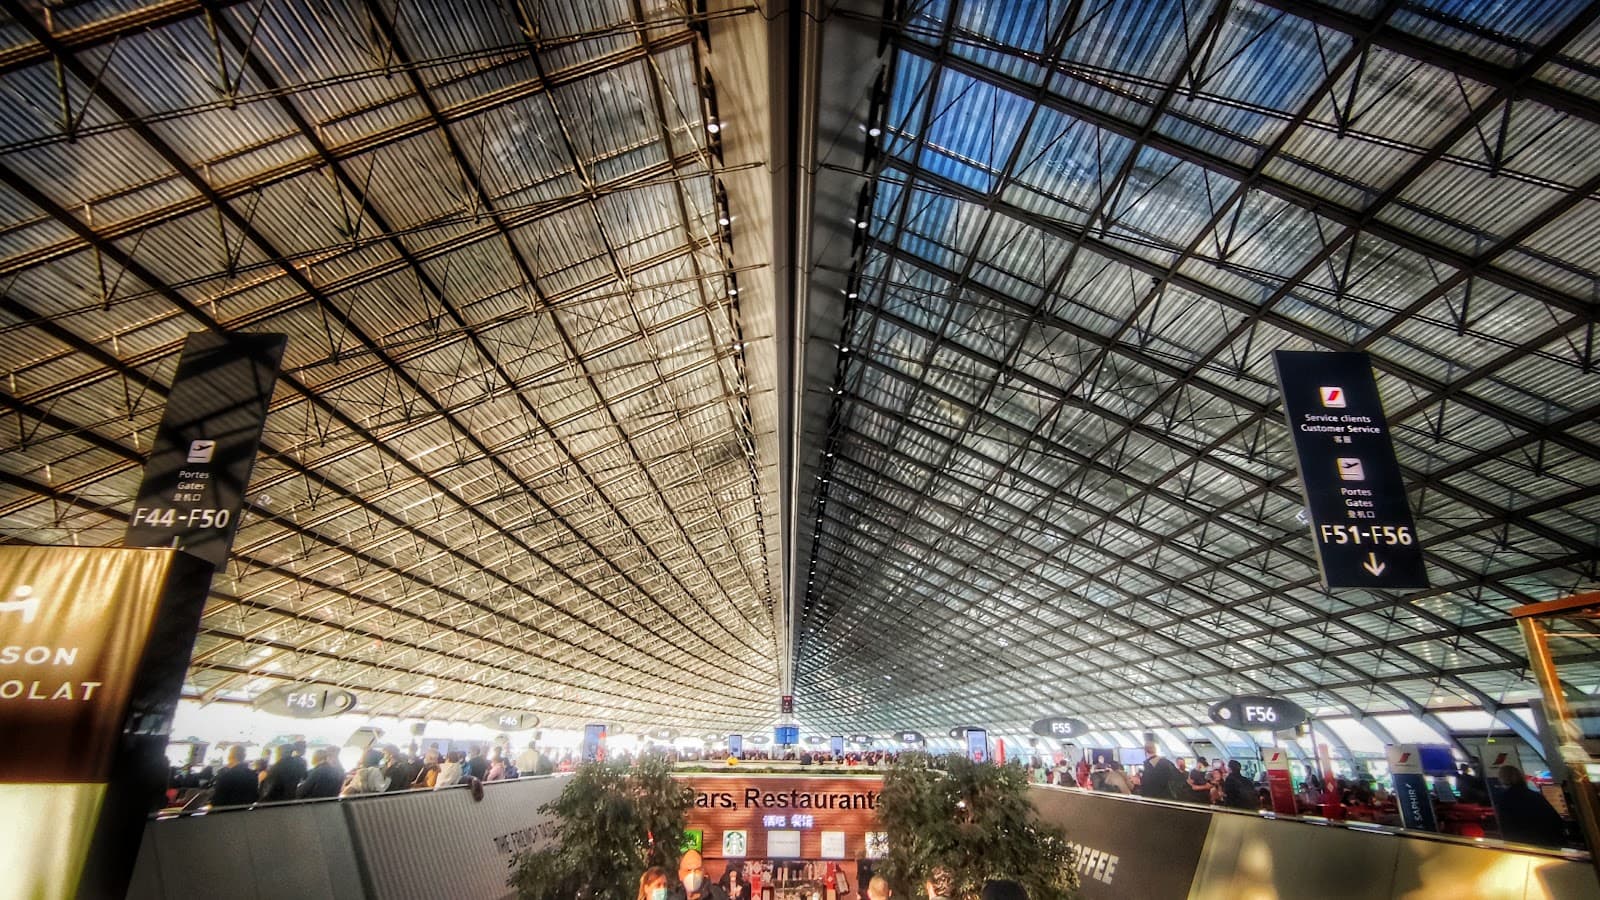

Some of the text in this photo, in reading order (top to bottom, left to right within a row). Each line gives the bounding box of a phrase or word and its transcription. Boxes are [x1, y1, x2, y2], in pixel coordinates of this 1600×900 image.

[1304, 413, 1371, 424] Service clients
[1300, 423, 1381, 434] Customer Service
[178, 470, 210, 480] Portes
[177, 481, 206, 491] Gates
[1341, 487, 1373, 497] Portes
[1345, 498, 1374, 508] Gates
[132, 507, 231, 529] F44-F50
[1320, 523, 1413, 546] F51-F56
[286, 692, 318, 710] F45
[498, 714, 518, 727] F46
[1245, 705, 1278, 723] F56
[1051, 721, 1072, 735] F55
[1408, 788, 1423, 822] SAPHIR
[1067, 841, 1120, 885] OFFEE
